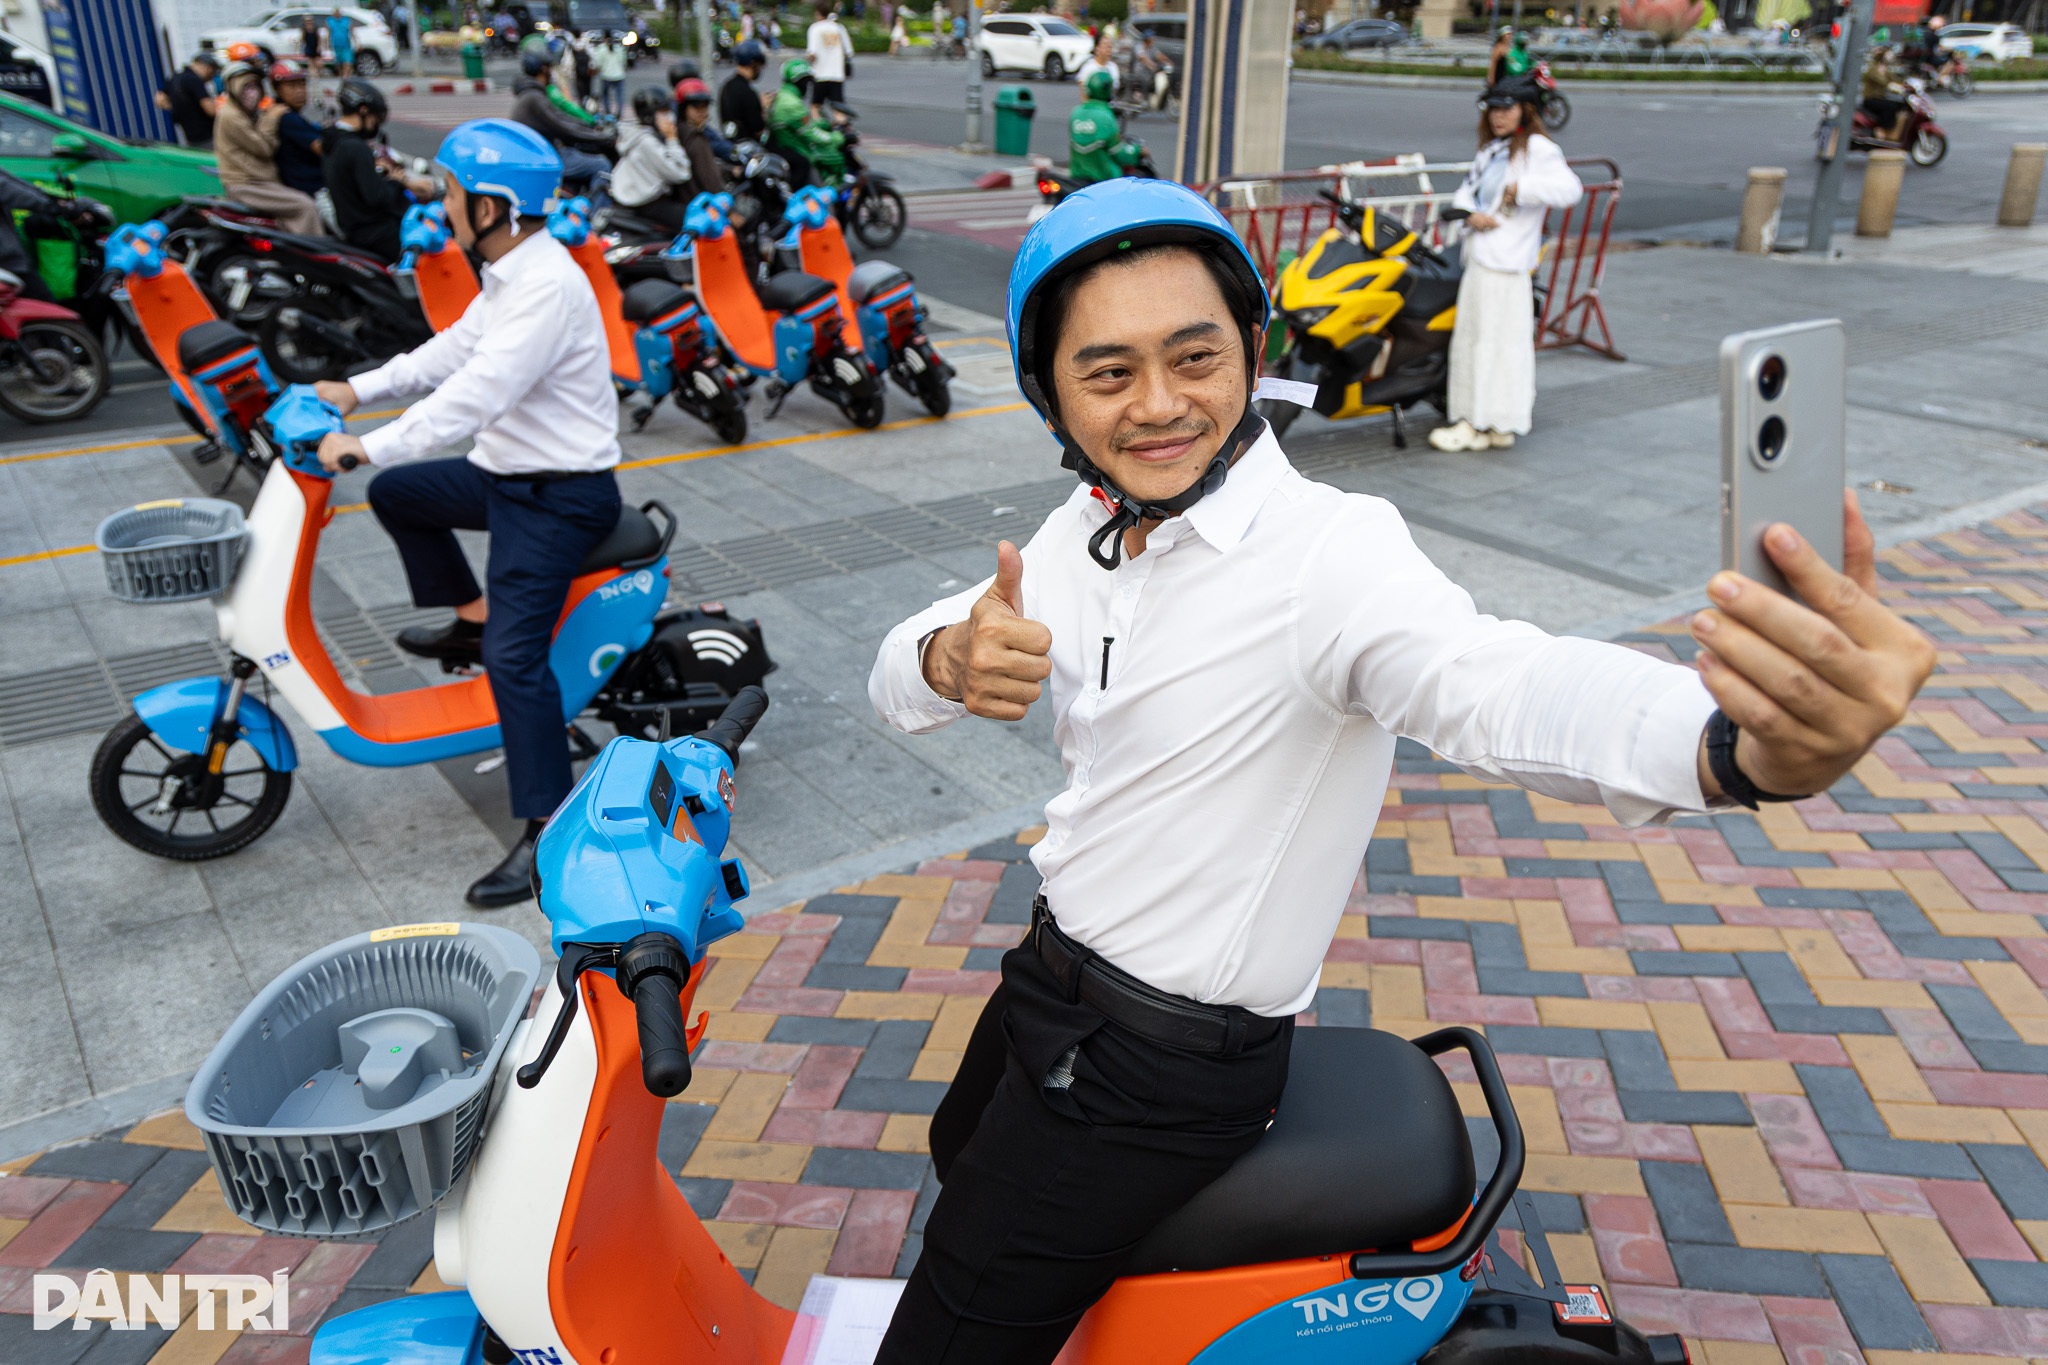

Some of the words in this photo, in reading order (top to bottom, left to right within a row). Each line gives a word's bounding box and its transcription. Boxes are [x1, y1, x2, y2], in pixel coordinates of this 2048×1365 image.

[1292, 1293, 1349, 1324] TN
[1296, 1328, 1315, 1338] Kết
[1316, 1324, 1334, 1335] nối
[1335, 1321, 1359, 1332] giao
[1361, 1314, 1393, 1326] thông
